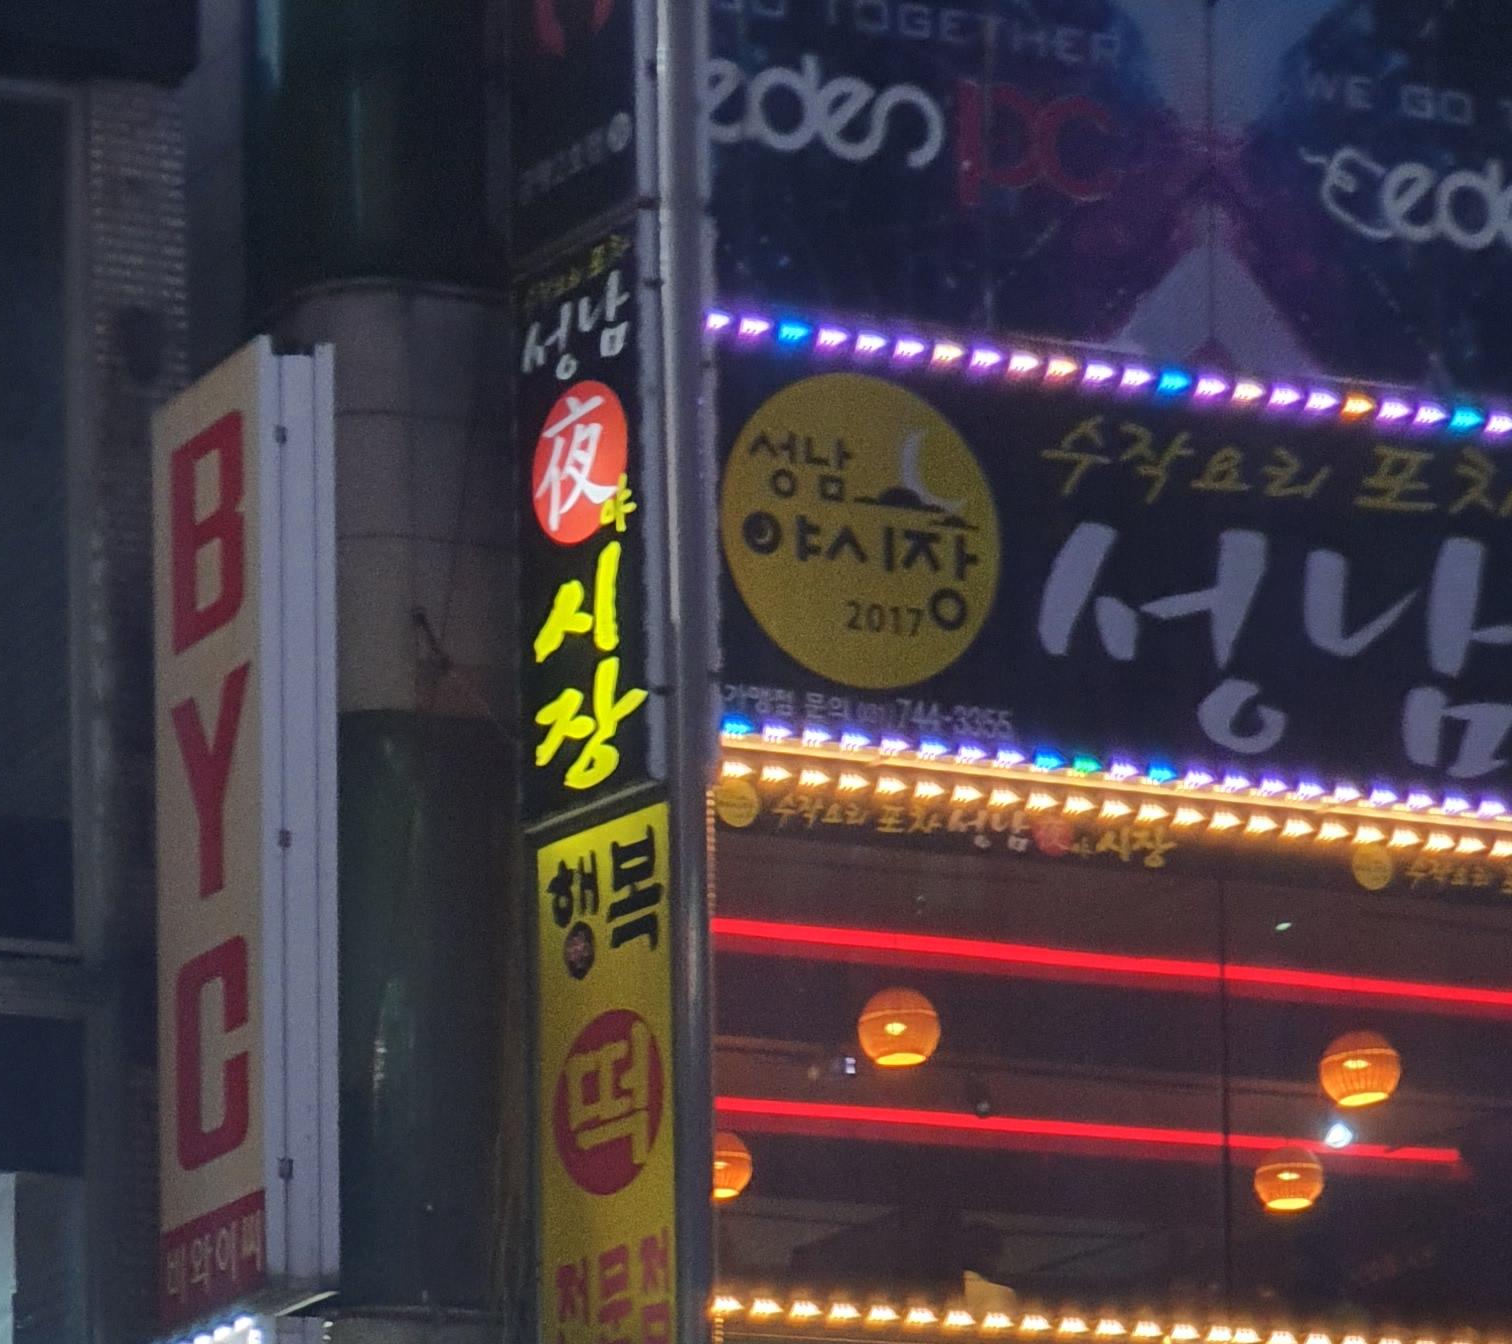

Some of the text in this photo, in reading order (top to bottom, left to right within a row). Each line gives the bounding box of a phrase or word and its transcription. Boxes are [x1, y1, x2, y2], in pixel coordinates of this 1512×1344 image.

[1400, 83, 1475, 126] GO
[522, 270, 630, 380] 성남
[534, 394, 619, 532] 夜
[748, 429, 852, 498] 성남
[1040, 414, 1333, 504] 수작요리
[742, 508, 980, 631] 야시장
[844, 600, 924, 638] 2017
[534, 541, 649, 788] 시장
[170, 409, 252, 1173] BYC
